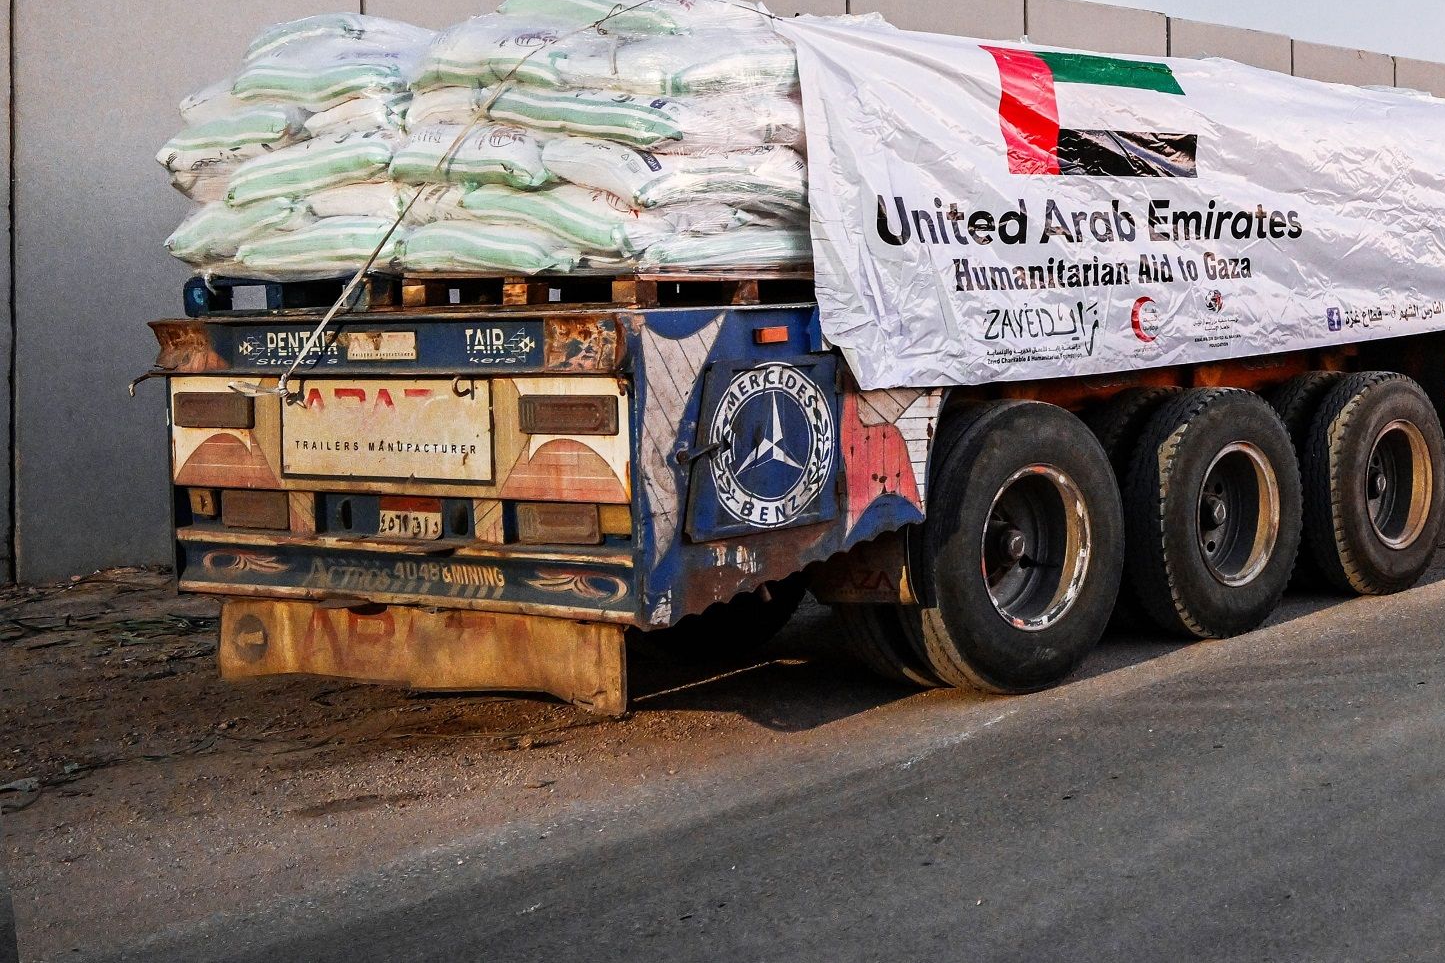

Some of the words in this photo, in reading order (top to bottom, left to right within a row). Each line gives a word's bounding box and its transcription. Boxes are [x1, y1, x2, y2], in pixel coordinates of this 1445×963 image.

[877, 194, 1028, 246] United
[1039, 198, 1136, 244] Arab
[1147, 199, 1303, 242] Emirates
[952, 256, 1130, 291] Humanitarian
[1138, 253, 1174, 283] Aid
[1178, 255, 1199, 282] to
[1203, 251, 1252, 281] Gaza
[985, 306, 1054, 340] ZAYED
[1345, 309, 1361, 329] غزة
[1362, 306, 1383, 328] قطاع
[295, 440, 359, 451] TRAILERS
[740, 495, 801, 522] BENZ
